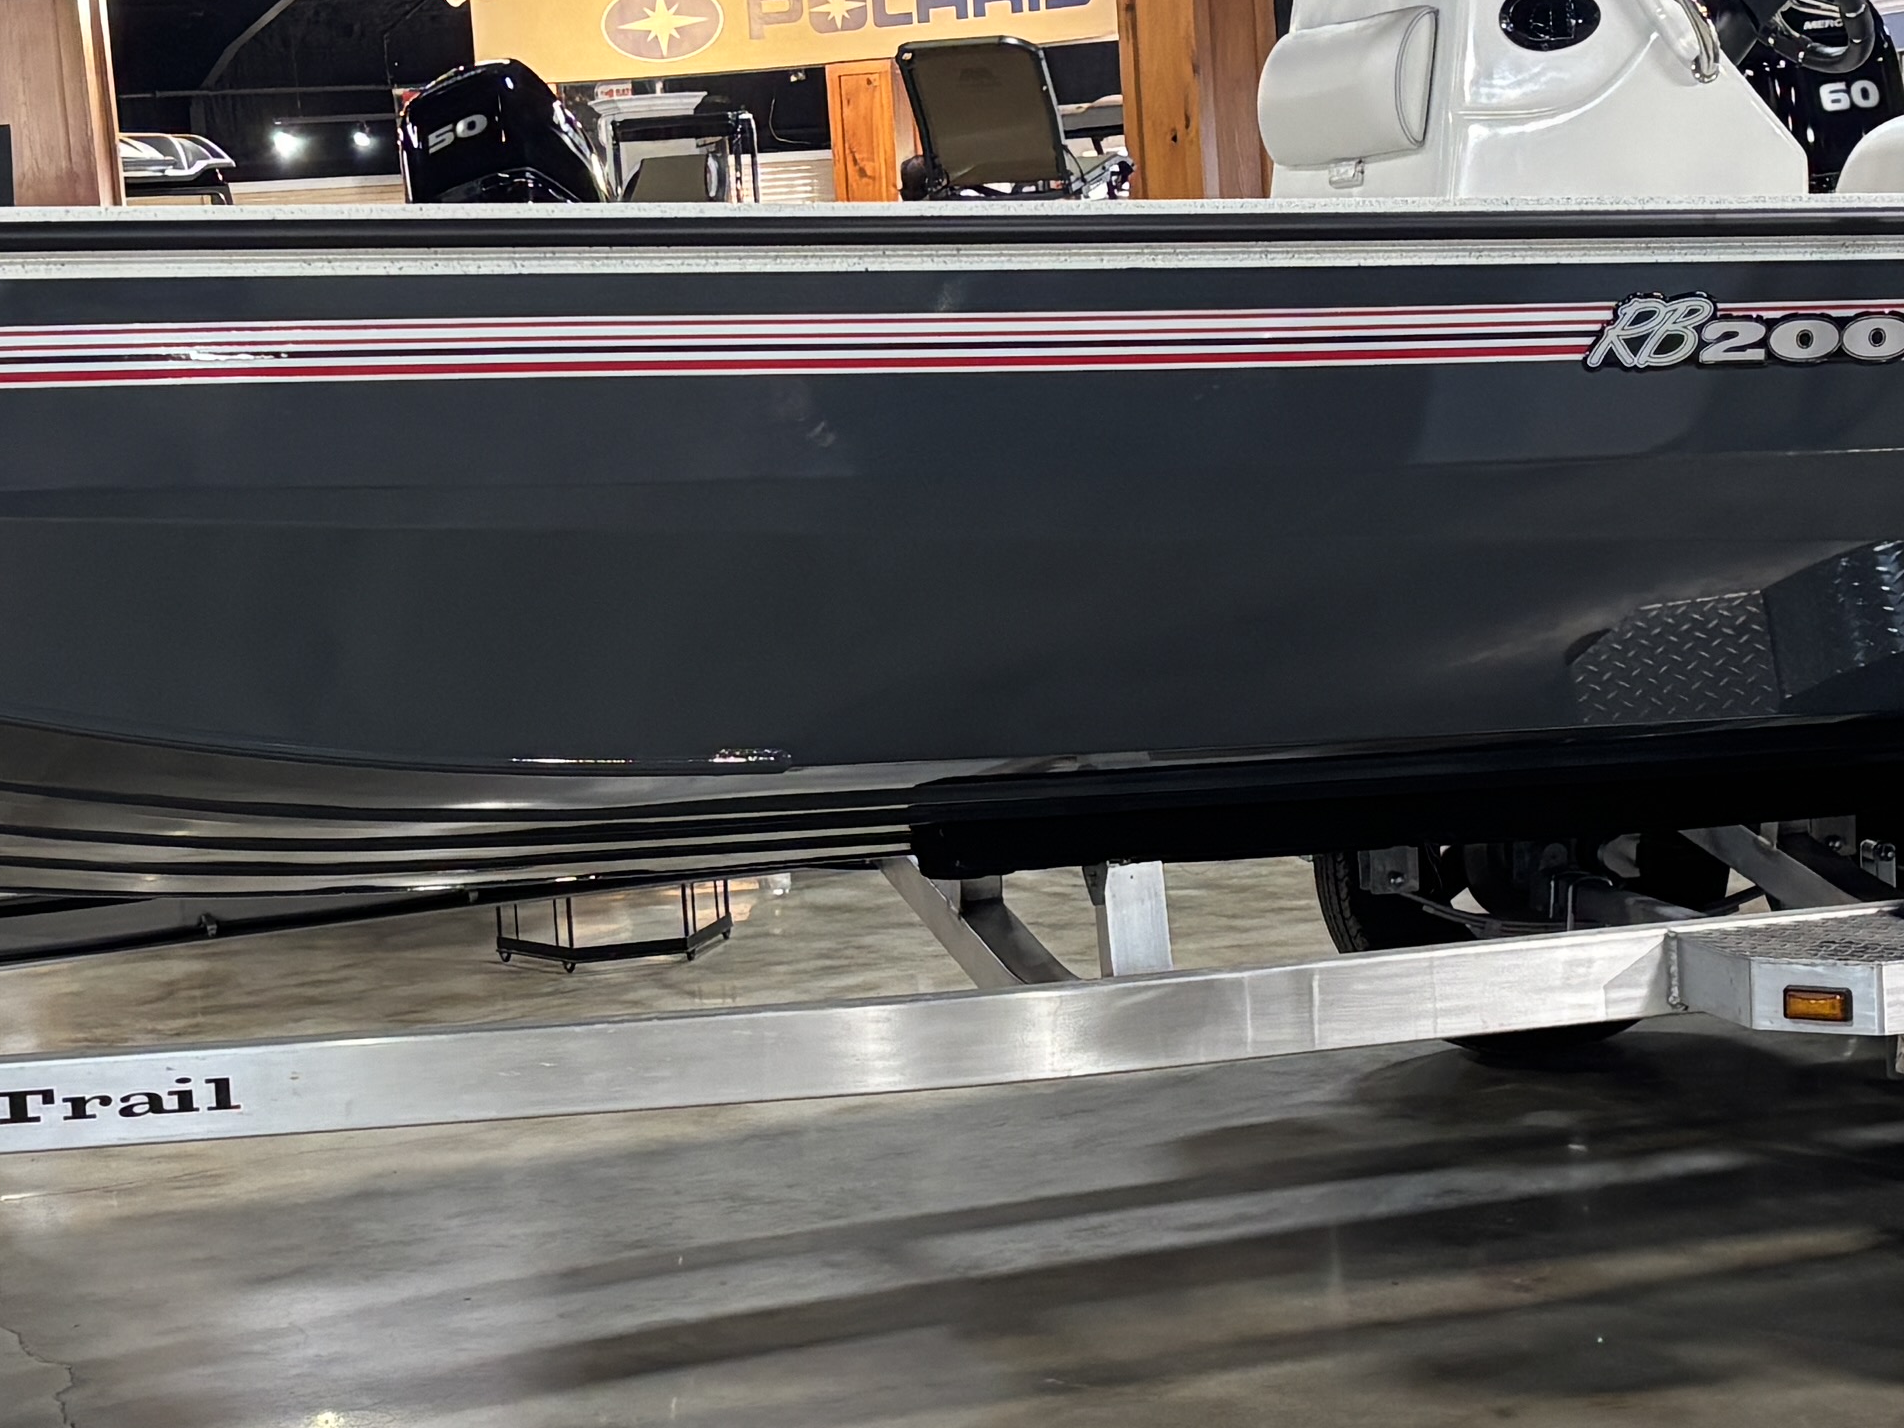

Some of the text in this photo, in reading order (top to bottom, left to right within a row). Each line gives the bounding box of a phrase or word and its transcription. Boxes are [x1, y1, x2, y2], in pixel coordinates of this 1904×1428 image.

[1803, 18, 1844, 31] MERC
[1819, 79, 1880, 113] 60
[428, 112, 488, 156] 50
